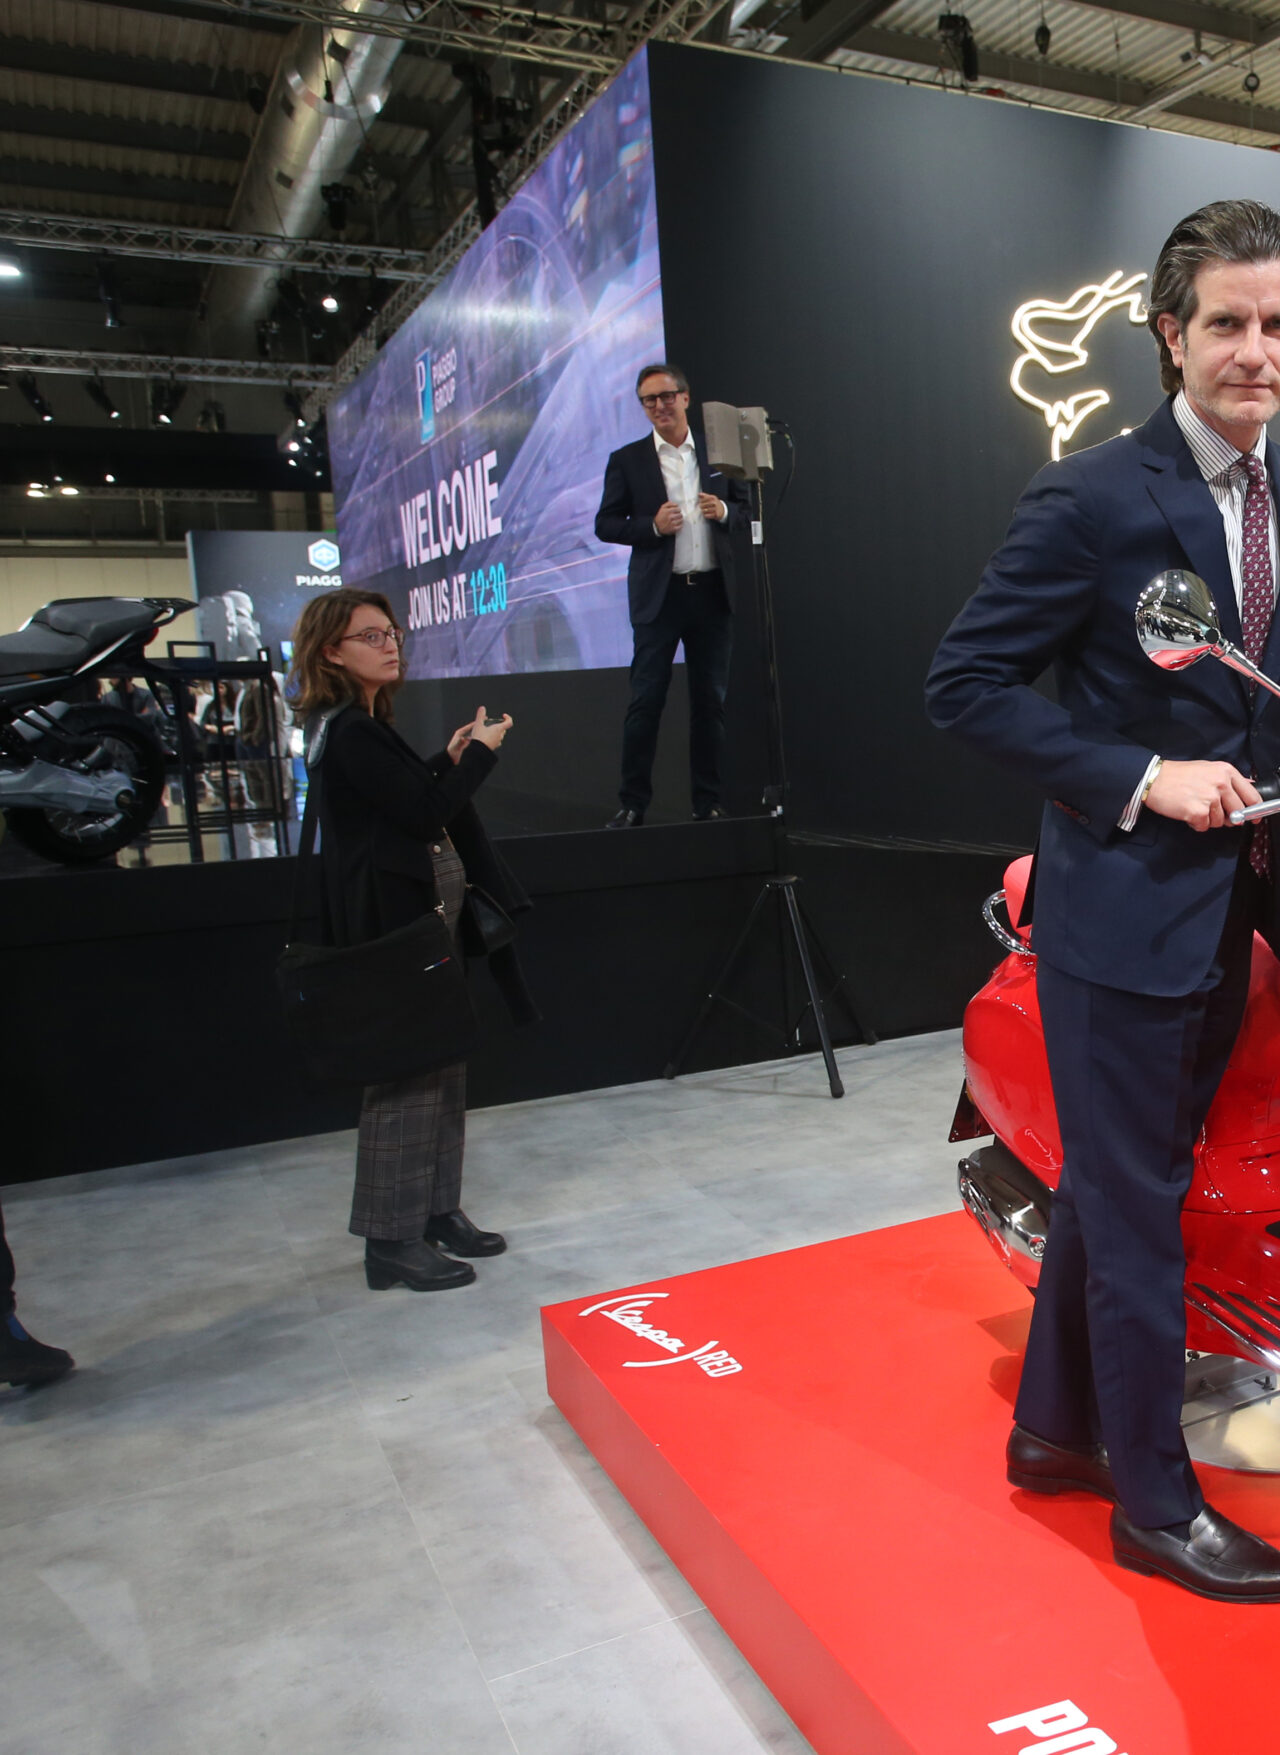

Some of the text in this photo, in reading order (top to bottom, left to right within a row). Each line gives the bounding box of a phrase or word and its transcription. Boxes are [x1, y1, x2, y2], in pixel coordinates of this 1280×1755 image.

[400, 450, 503, 569] WELCOME
[408, 561, 508, 631] JOIN US AT 12:30
[693, 1350, 744, 1378] RED
